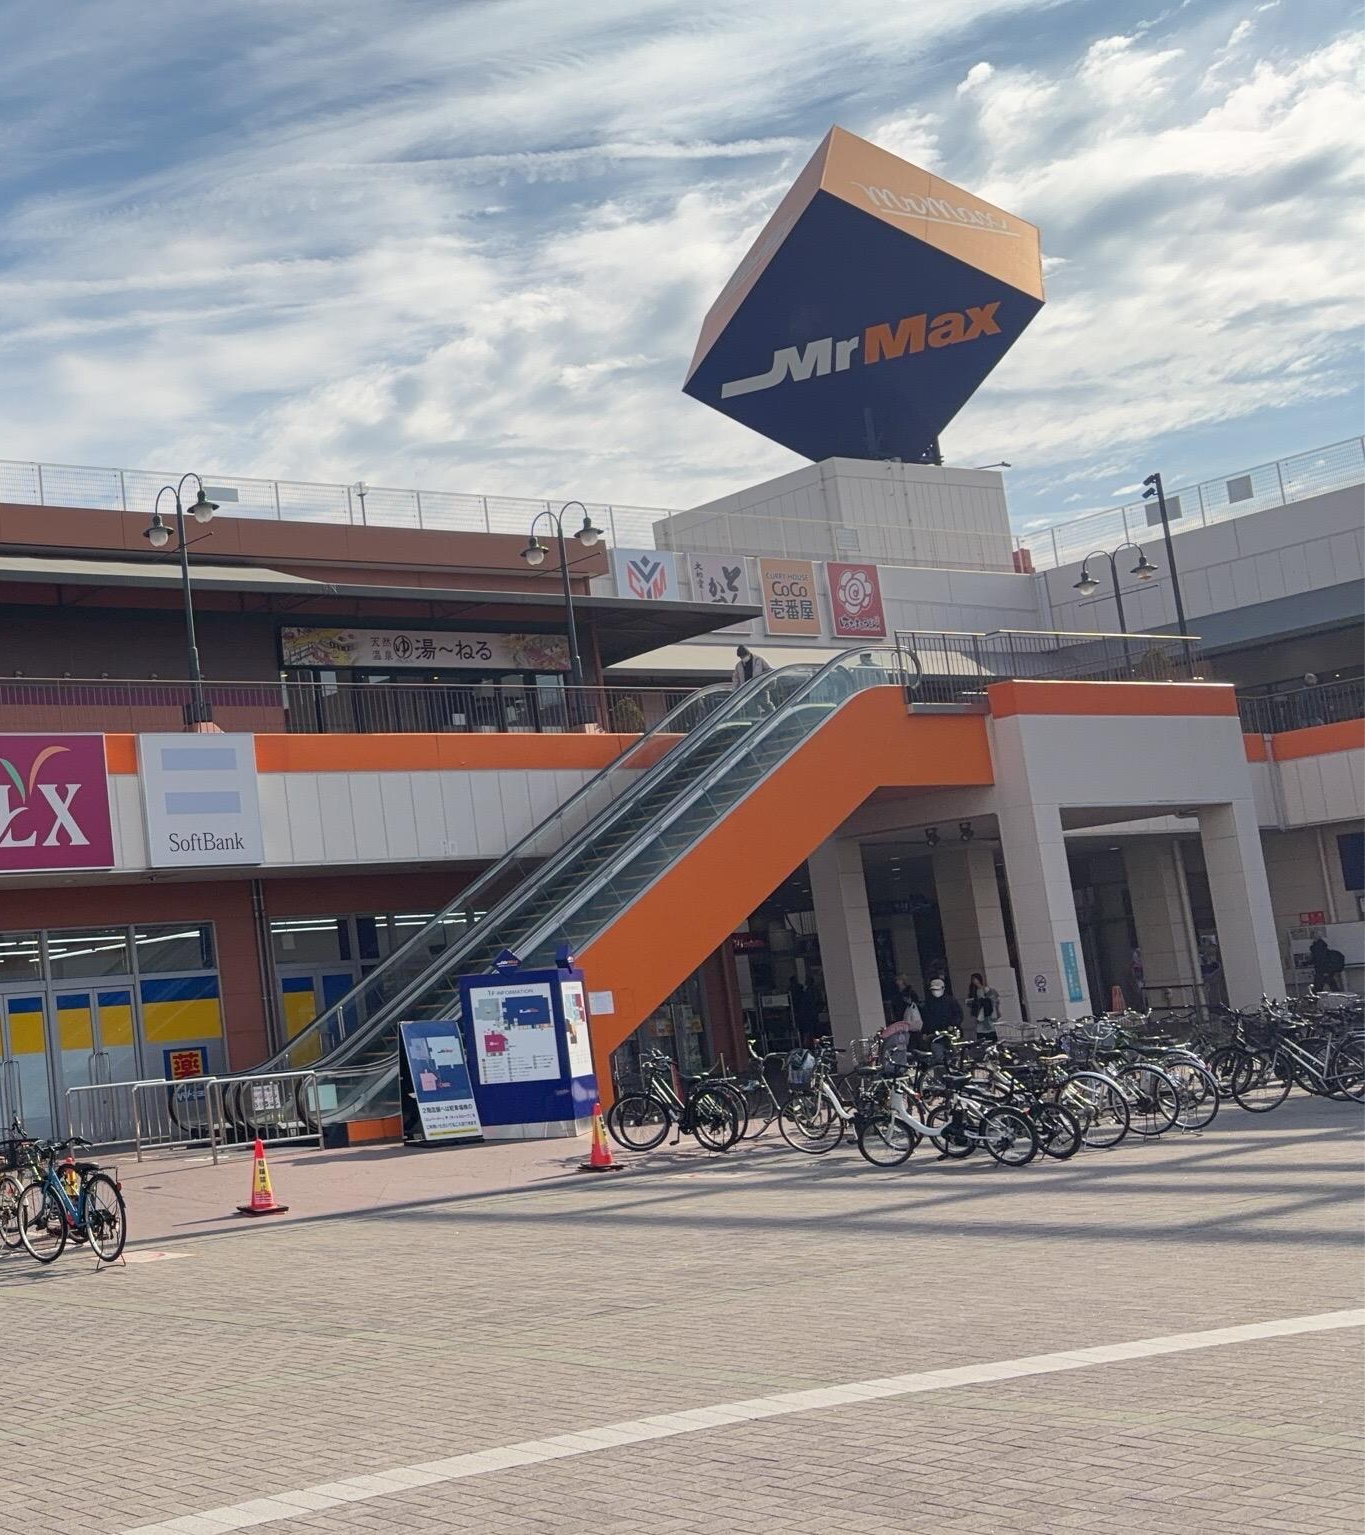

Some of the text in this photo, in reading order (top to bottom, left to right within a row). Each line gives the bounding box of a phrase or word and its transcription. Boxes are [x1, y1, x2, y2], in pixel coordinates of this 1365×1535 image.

[721, 302, 1002, 399] MrMax
[772, 581, 807, 597] CoCo
[770, 598, 814, 619] 壱番屋
[169, 832, 245, 854] SoftBank
